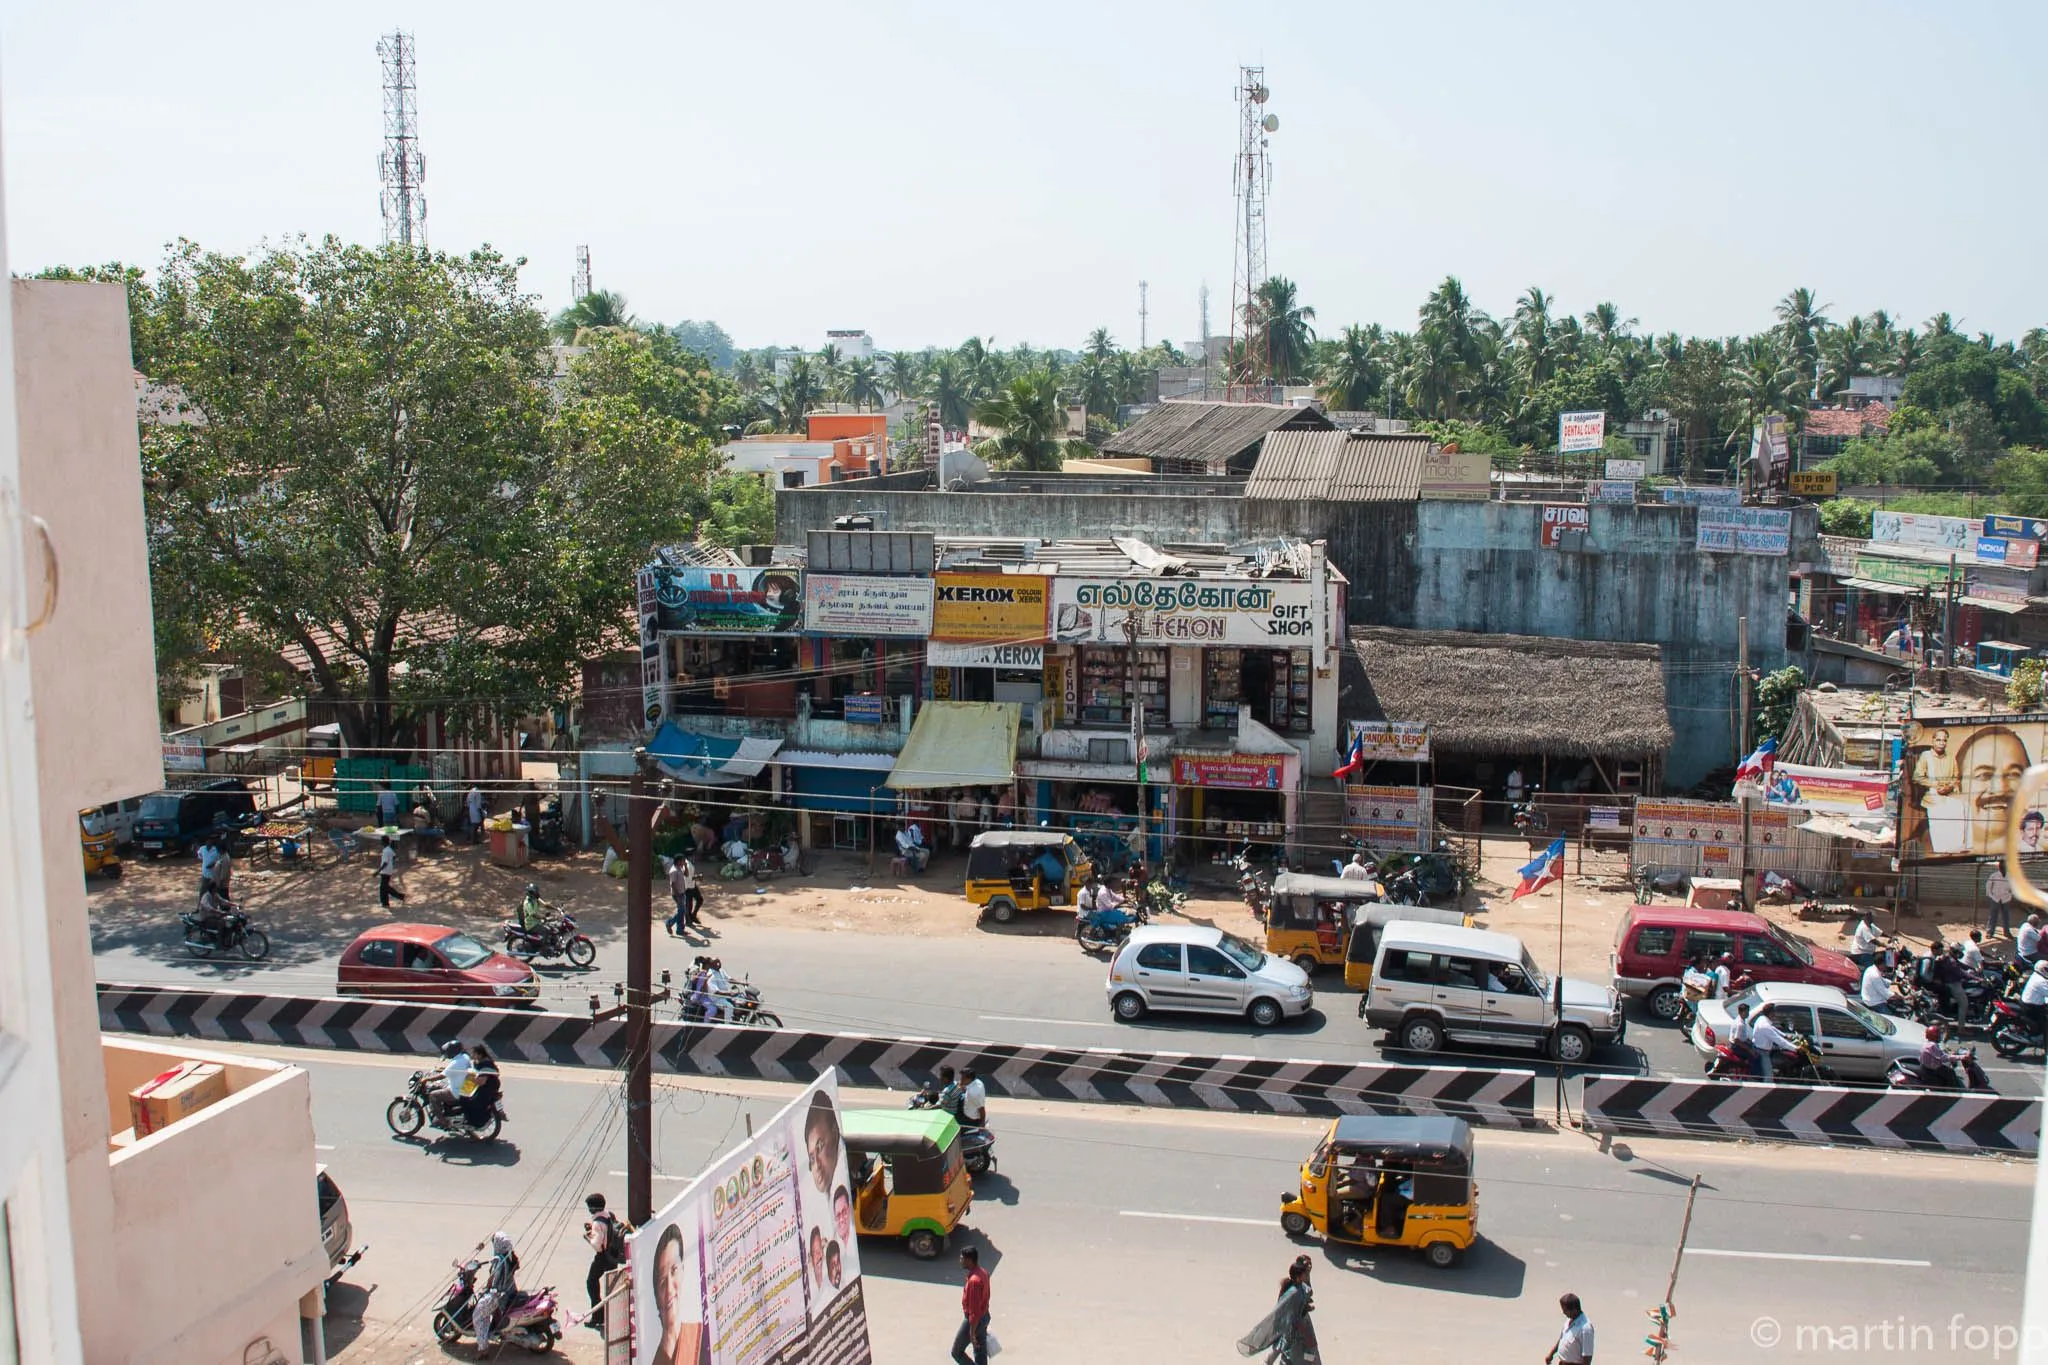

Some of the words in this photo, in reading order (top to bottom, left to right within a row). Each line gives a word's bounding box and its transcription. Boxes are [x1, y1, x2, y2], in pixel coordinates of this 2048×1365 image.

[1564, 424, 1583, 436] DENTAL
[1584, 423, 1600, 435] CLINIC
[1978, 543, 2005, 553] NOKIA
[937, 587, 1015, 602] XEROX
[1076, 580, 1275, 611] எல்தேகோன்
[1272, 605, 1308, 619] GIFT
[1268, 620, 1313, 636] SHOP
[993, 646, 1041, 665] XEROX
